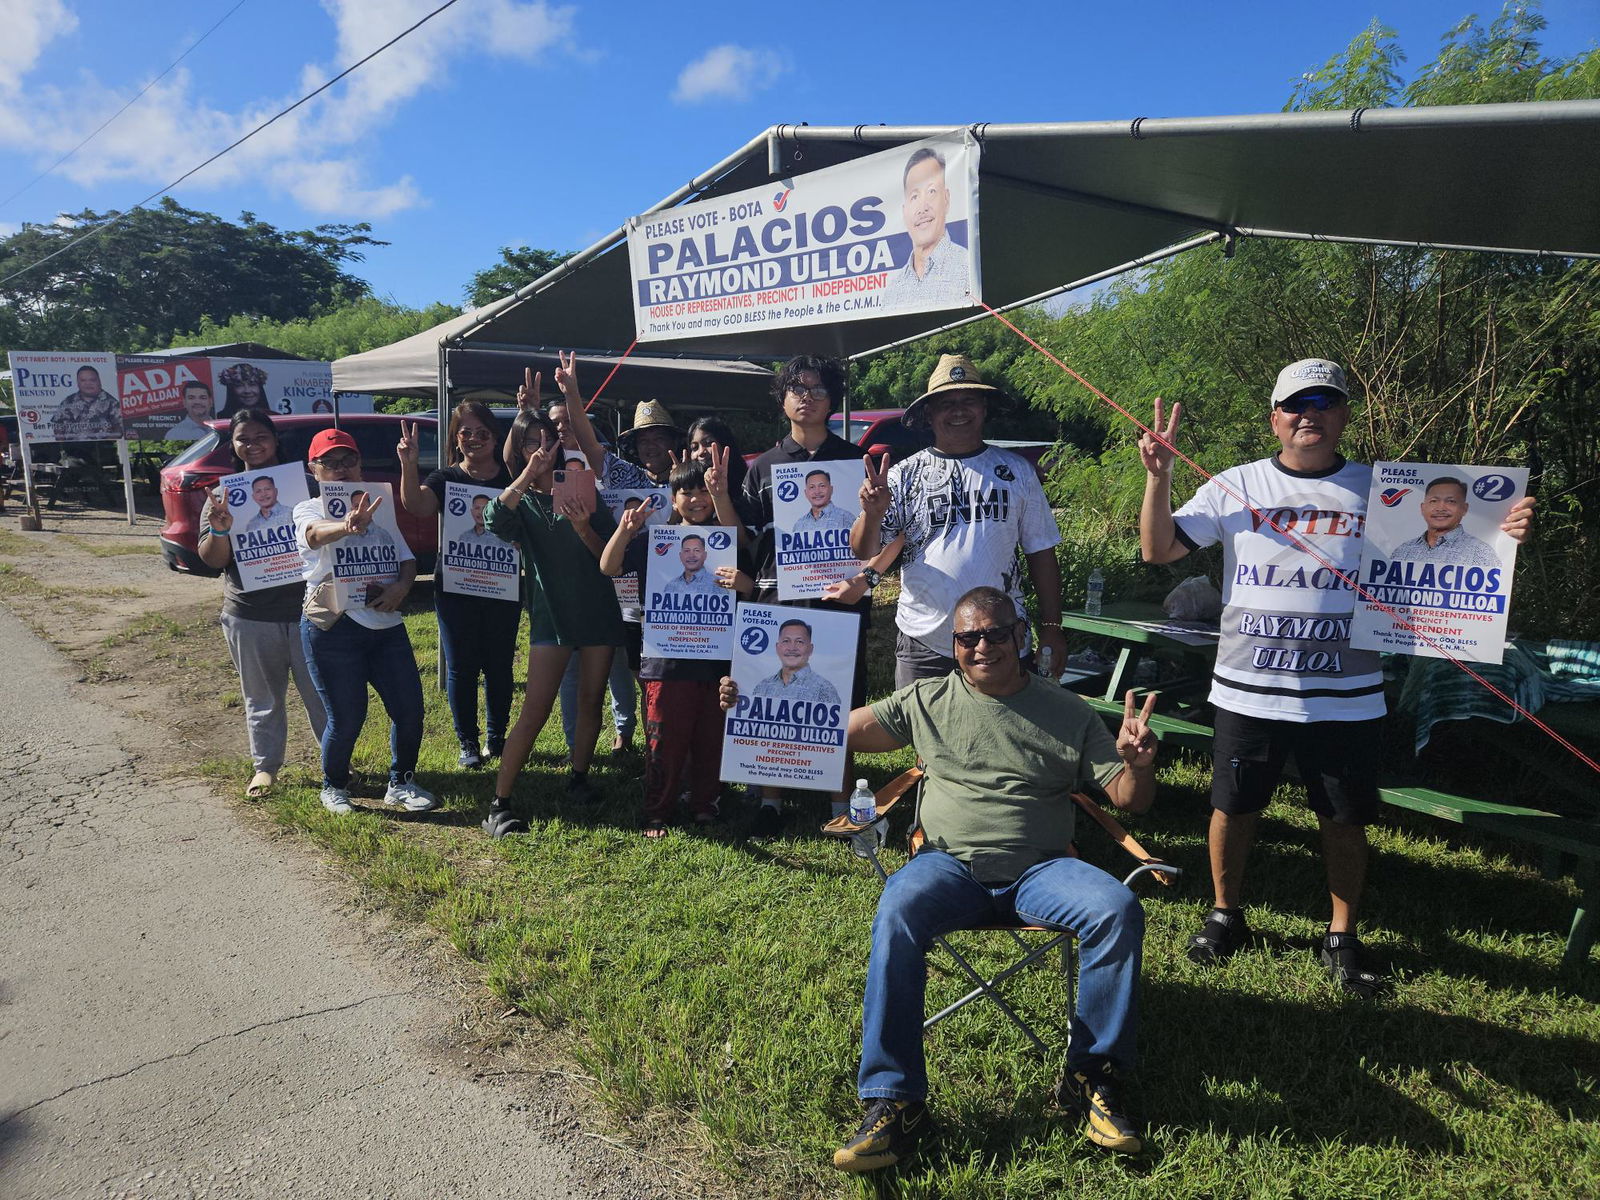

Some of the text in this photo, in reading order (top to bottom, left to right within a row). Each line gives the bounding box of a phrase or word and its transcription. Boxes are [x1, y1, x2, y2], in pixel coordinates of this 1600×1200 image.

[646, 219, 684, 239] PLEASE
[688, 211, 718, 230] VOTE
[729, 201, 763, 222] BOTA
[648, 196, 886, 275] PALACIOS
[649, 240, 894, 303] RAYMOND ULLOA
[650, 273, 887, 318] HOUSE OF REPRESENTATIVES, PRECINCT 1 INDEPENDENT
[650, 296, 881, 332] Thank You and may GOD BLESS the People & the C.N.M.I.
[123, 365, 198, 395] ADA
[294, 378, 332, 387] KIMBER
[122, 394, 143, 408] ROY
[147, 387, 180, 403] ALDAN
[224, 476, 244, 484] PLEASE
[1381, 468, 1417, 476] PLEASE
[1381, 477, 1424, 486] VOTE-BOTA
[778, 482, 795, 499] #2
[1475, 476, 1503, 500] #2
[329, 501, 343, 516] #2
[449, 500, 463, 514] #2
[927, 489, 1009, 527] CNMI
[1250, 508, 1364, 538] VOTE!
[709, 533, 725, 548] #2
[782, 529, 851, 551] PALACIO
[240, 544, 286, 560] RAYMOND
[336, 545, 396, 564] PALACIOS
[449, 540, 514, 562] PALACIOS
[782, 550, 830, 564] RAYMOND
[338, 562, 397, 576] RAYMOND ULLOA
[448, 557, 514, 573] RAYMOND ULLOA
[1236, 565, 1359, 590] PALACIO
[1369, 560, 1501, 593] PALACIOS
[652, 593, 730, 612] PALACIOS
[1366, 586, 1498, 612] RAYMOND ULLOA
[650, 612, 729, 624] RAYMOND ULLOA
[743, 609, 772, 618] PLEASE
[743, 617, 778, 626] VOTE-BOTA
[1366, 605, 1395, 613] HOUSE
[1413, 608, 1493, 621] REPRESENTATIVES
[1407, 616, 1442, 624] PRECINCT
[1239, 613, 1352, 641] RAYMON
[1392, 623, 1463, 635] INDEPENDENT
[742, 629, 763, 651] #2
[1395, 639, 1417, 647] People
[1253, 646, 1342, 672] ULLOA
[735, 695, 841, 728] PALACIOS
[733, 721, 838, 744] RAYMOND ULLOA
[773, 742, 835, 753] REPRESENTATIVES
[756, 756, 812, 766] INDEPENDENT
